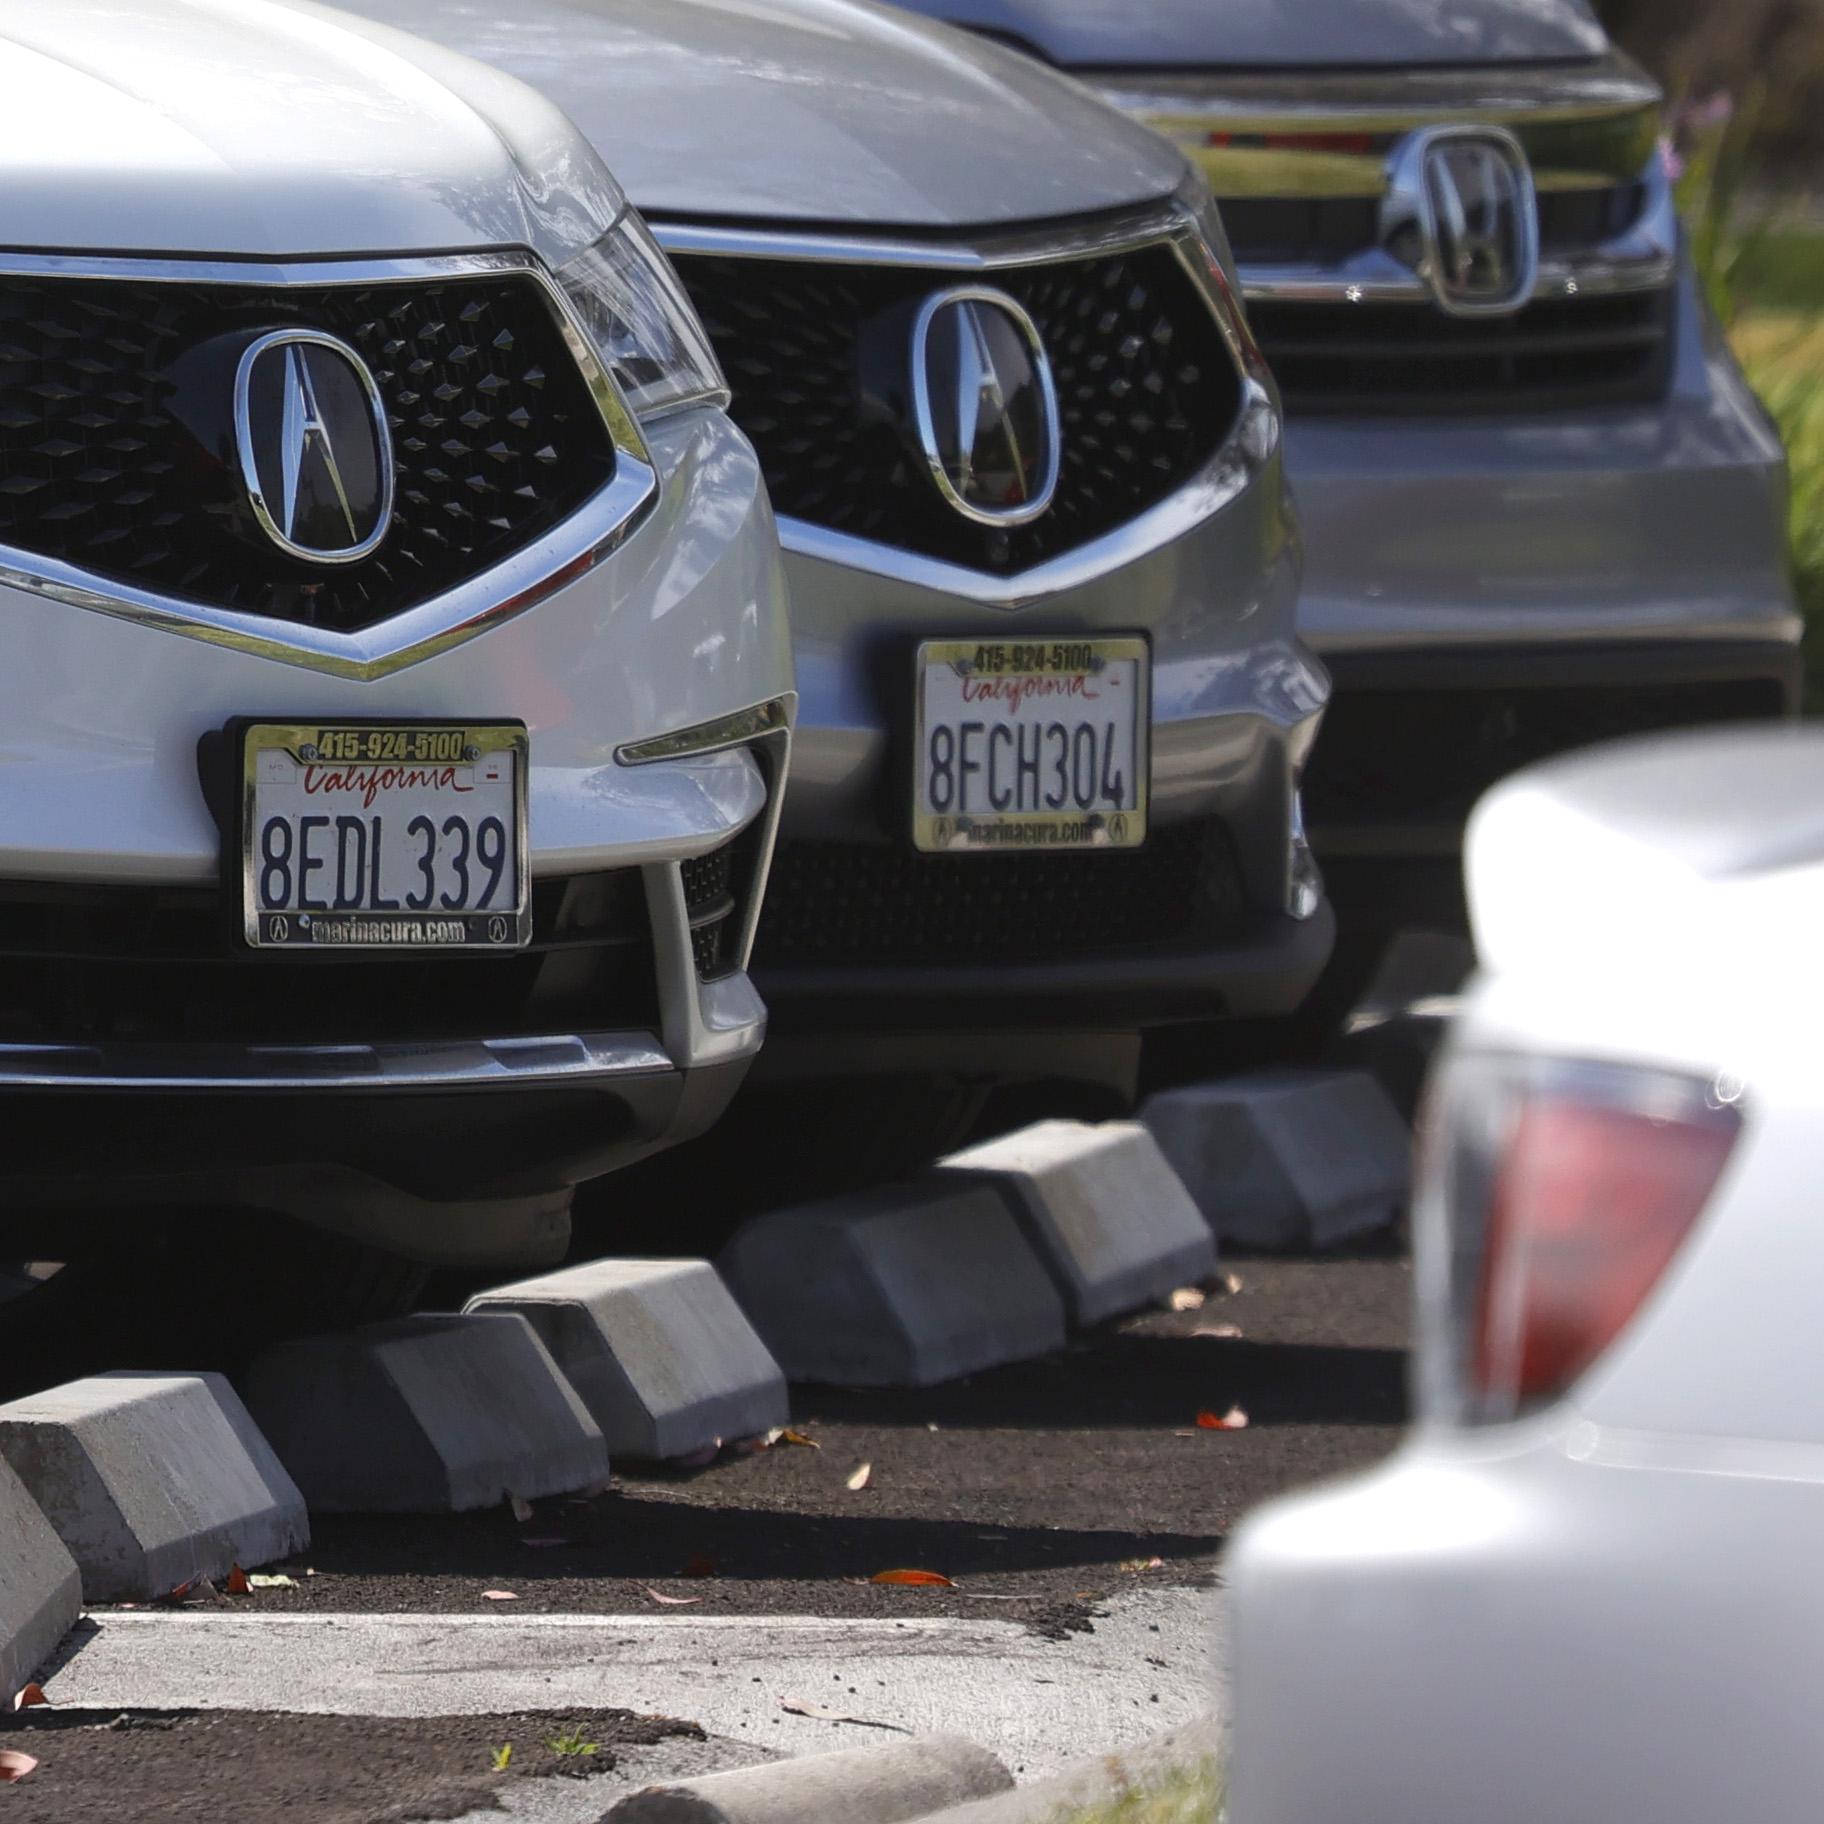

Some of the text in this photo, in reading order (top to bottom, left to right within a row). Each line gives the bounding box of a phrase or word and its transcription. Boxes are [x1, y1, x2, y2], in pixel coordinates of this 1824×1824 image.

[974, 644, 1092, 673] 415-924-5100
[961, 675, 1100, 716] California
[317, 730, 463, 761] 415-924-5100
[303, 764, 475, 809] California
[929, 721, 1124, 813] 8FCH304
[260, 815, 506, 910] 8EDL339
[311, 917, 466, 944] marinacura.com
